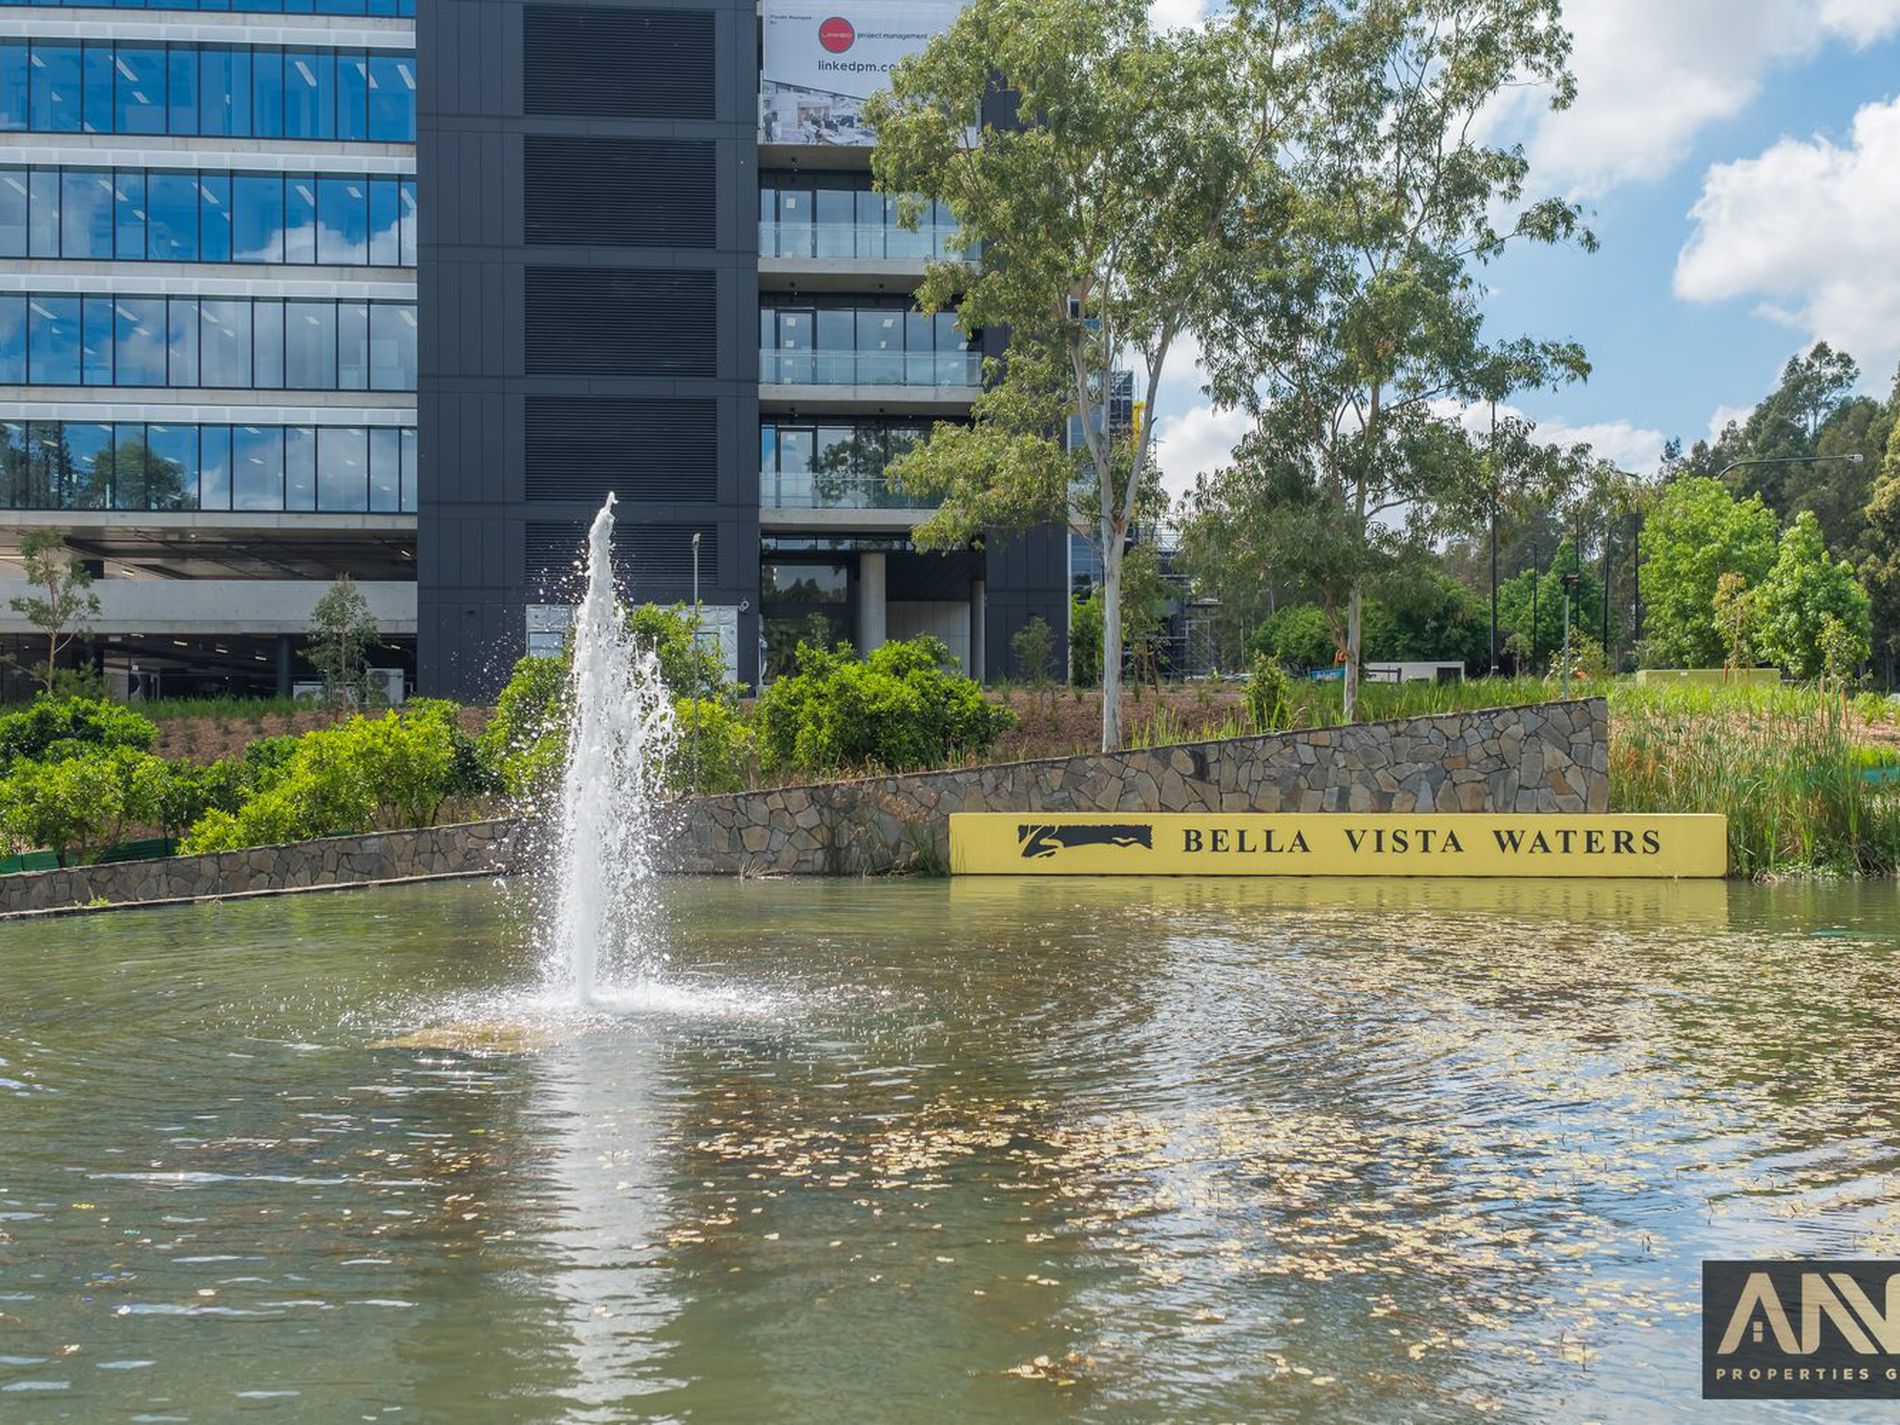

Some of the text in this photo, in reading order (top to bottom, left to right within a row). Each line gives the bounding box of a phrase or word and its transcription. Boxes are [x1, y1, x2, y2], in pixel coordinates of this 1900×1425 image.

[883, 33, 928, 41] management
[1182, 829, 1660, 854] BELLA VISTA WATERS
